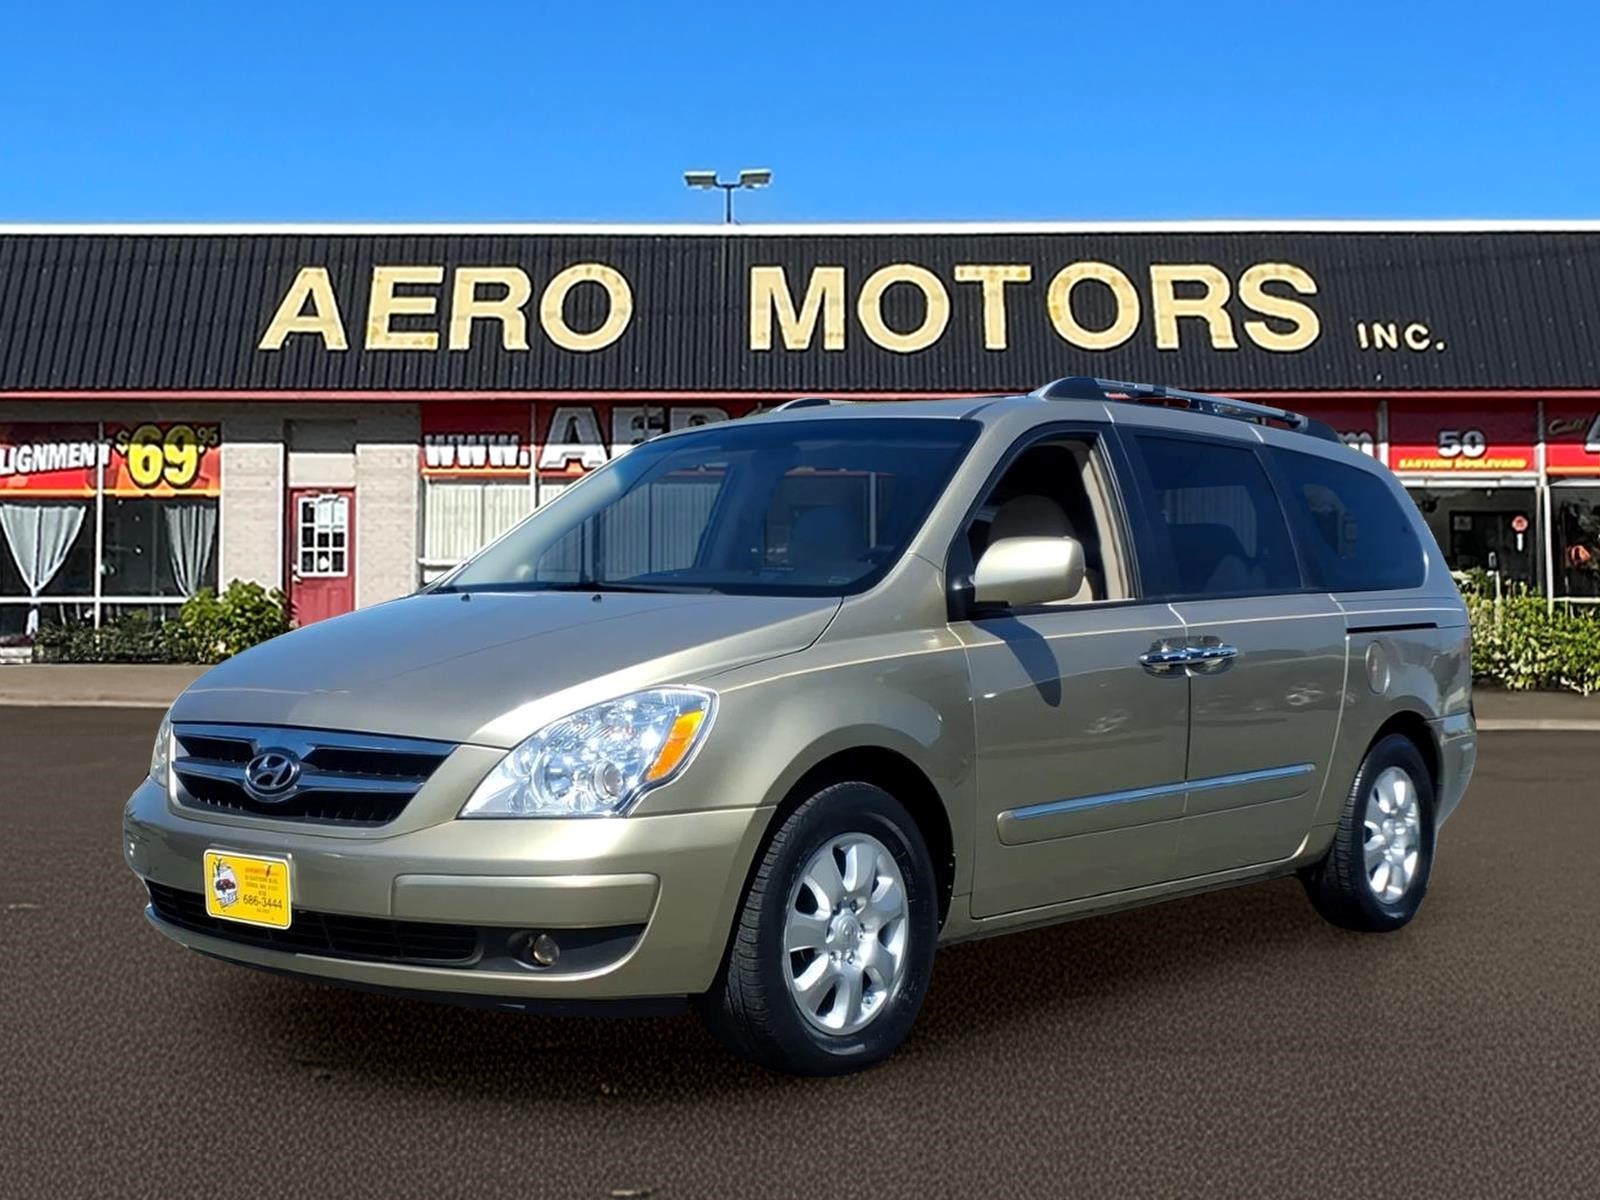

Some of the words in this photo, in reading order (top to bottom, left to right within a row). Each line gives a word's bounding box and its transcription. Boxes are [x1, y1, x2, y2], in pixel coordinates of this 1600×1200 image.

[258, 263, 633, 353] AERO
[750, 262, 1320, 354] MOTORS
[1357, 322, 1445, 351] INC.
[1437, 430, 1486, 457] 50
[1399, 458, 1453, 469] EASTERN
[1455, 458, 1527, 469] BOULEVARD
[243, 894, 283, 910] 686-3444
